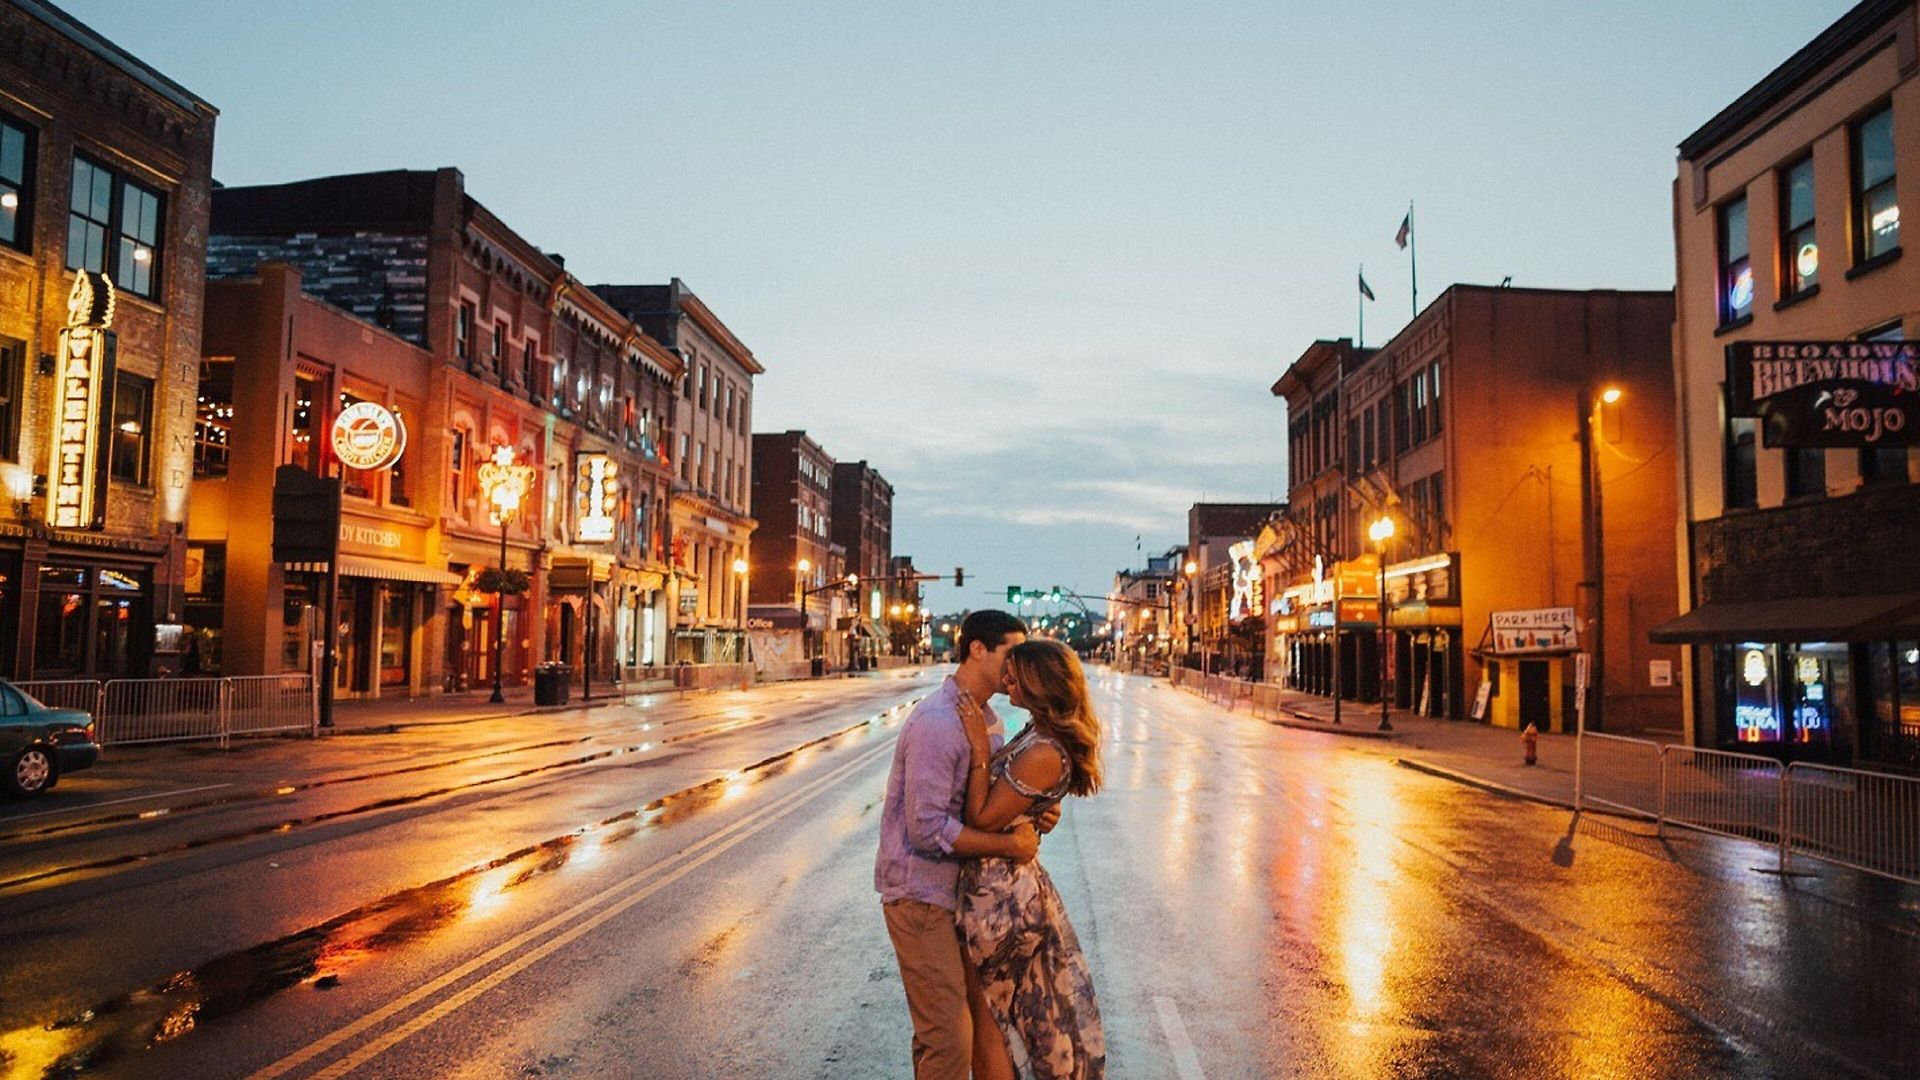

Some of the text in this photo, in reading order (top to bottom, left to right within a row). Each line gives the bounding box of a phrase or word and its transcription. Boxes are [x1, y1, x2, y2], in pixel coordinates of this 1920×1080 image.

[56, 338, 92, 527] VALENTINE
[1823, 407, 1906, 442] MOJO
[355, 526, 401, 548] KITCHEN
[1495, 614, 1528, 626] PARK
